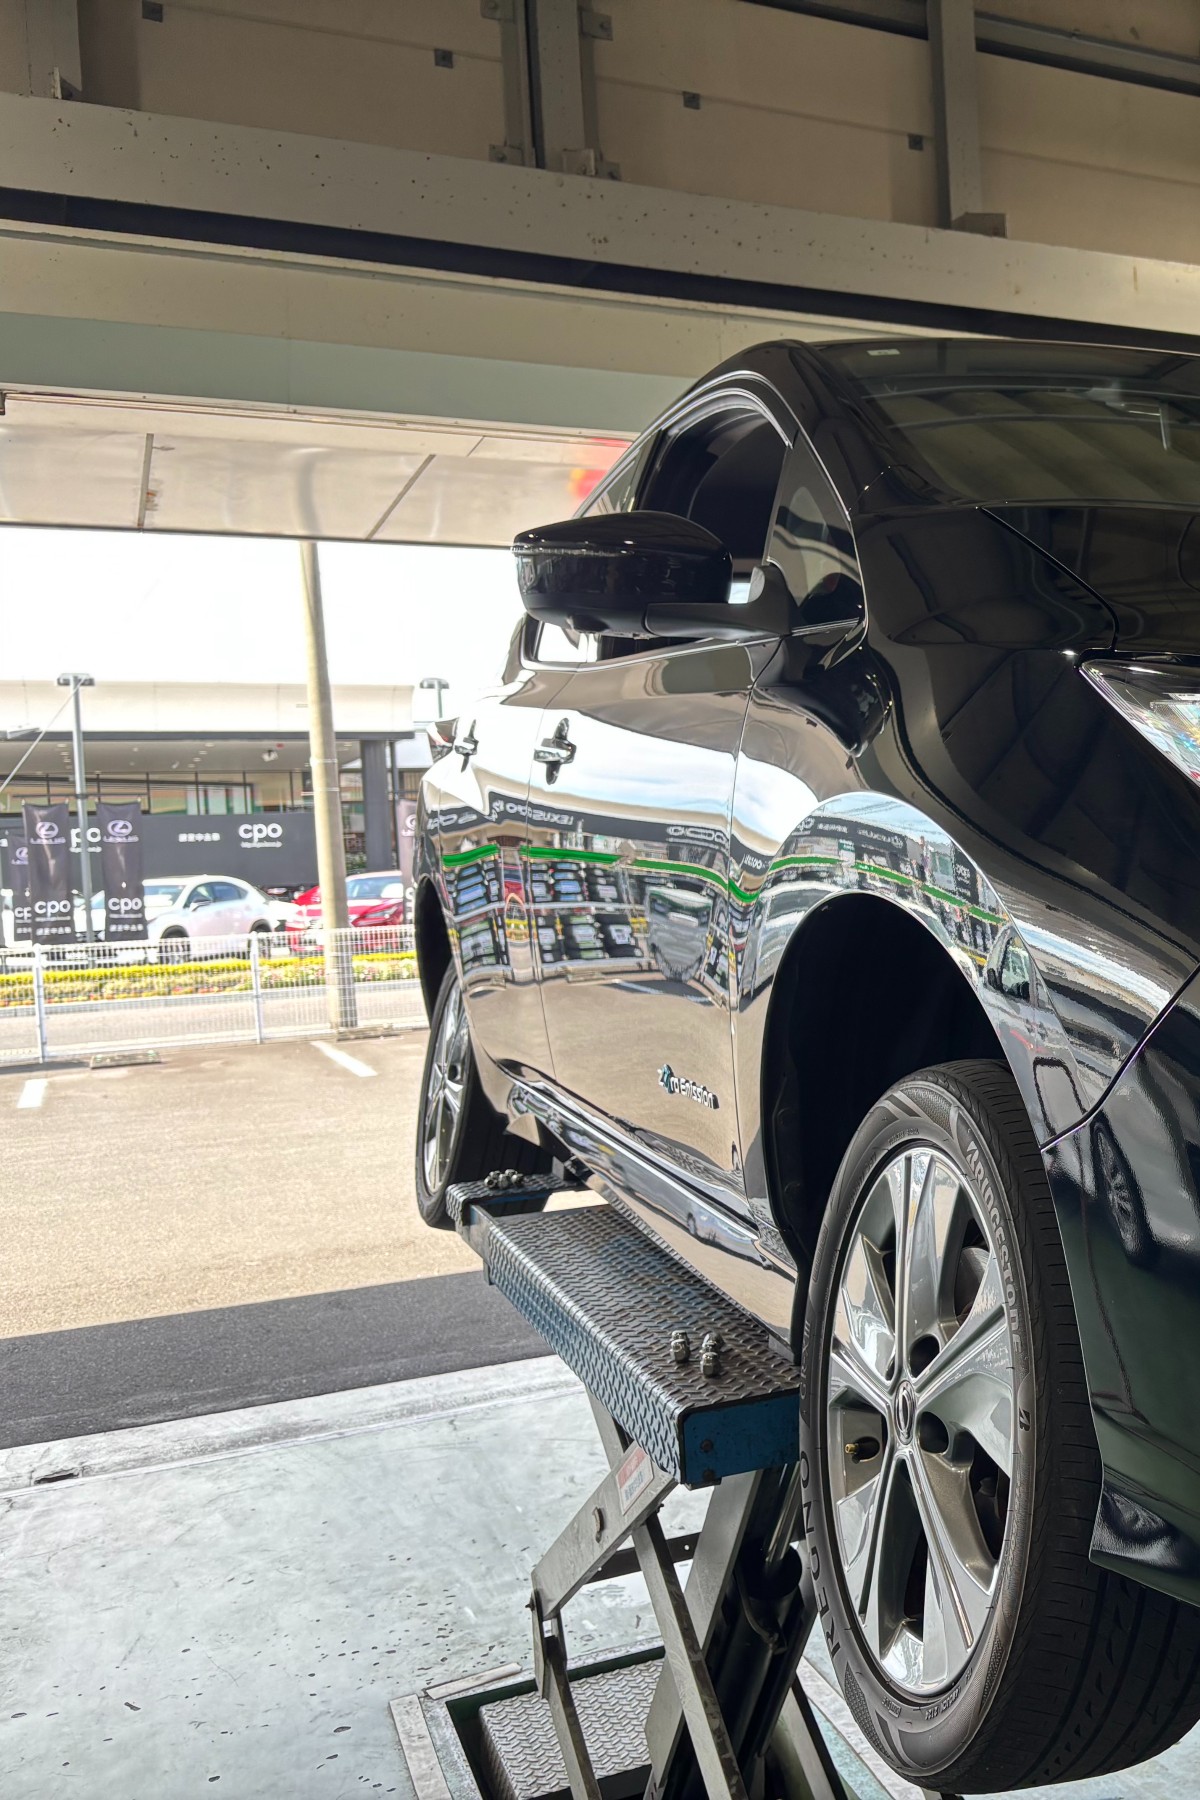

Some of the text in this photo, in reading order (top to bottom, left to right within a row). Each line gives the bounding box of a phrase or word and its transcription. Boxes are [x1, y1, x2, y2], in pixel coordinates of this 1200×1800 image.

[238, 823, 283, 844] cpo
[34, 900, 71, 919] cpo
[108, 897, 143, 915] cpo
[966, 1140, 1022, 1353] BRIDGESTONE
[800, 1450, 841, 1659] REGNO
